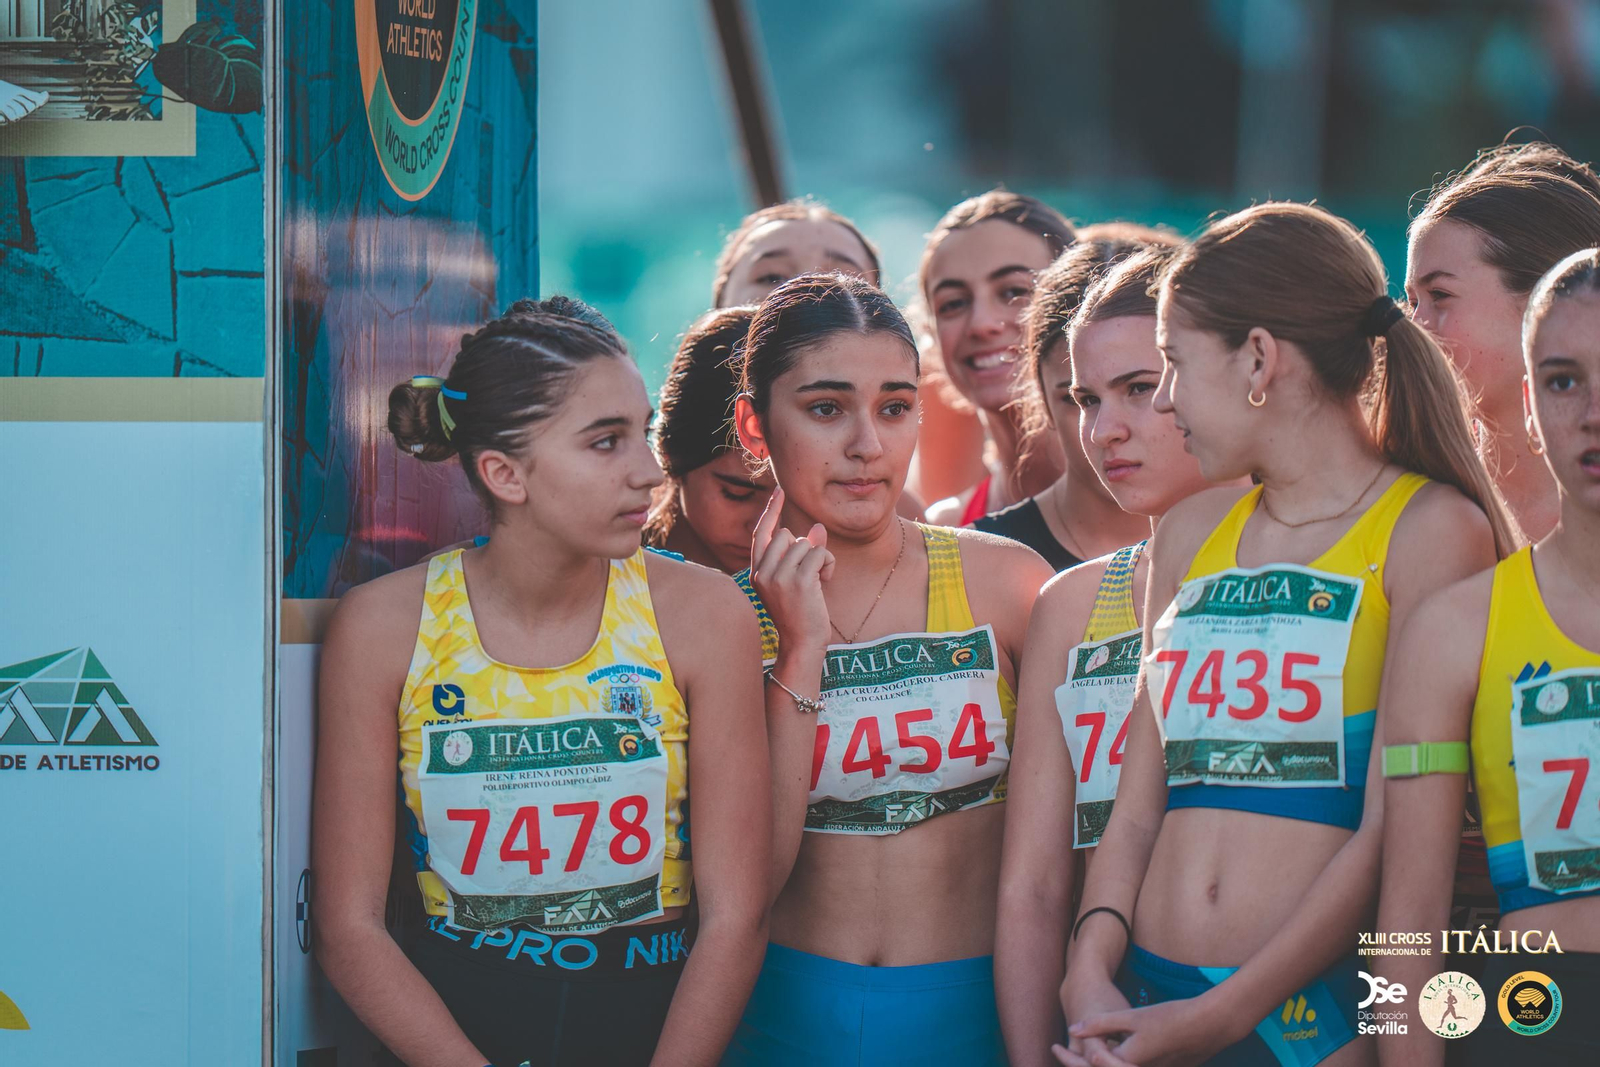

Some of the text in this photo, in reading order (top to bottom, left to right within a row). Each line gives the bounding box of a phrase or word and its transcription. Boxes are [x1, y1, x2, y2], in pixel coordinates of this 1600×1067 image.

[387, 22, 443, 62] ATHLETICS
[385, 117, 417, 174] WORLD
[419, 100, 450, 171] CROSS
[1209, 576, 1291, 603] ITÁLICA
[823, 643, 934, 677] ITÁLICA
[836, 689, 850, 697] LA
[852, 686, 880, 695] CRUZ
[881, 677, 937, 693] NOGUEROL
[939, 671, 985, 682] CABRERA
[868, 689, 912, 702] CALLENCE
[1104, 677, 1115, 686] DE
[1117, 677, 1128, 685] LA
[1156, 649, 1322, 724] 7435
[489, 726, 603, 756] ITÁLICA
[0, 754, 160, 771] DE ATLETISMO
[486, 765, 608, 782] IRENE REINA PONTONES
[483, 775, 612, 791] POLIDEPORTIVO OLIMPO CÁDIZ
[446, 794, 652, 876] 7478
[470, 927, 598, 970] PRO
